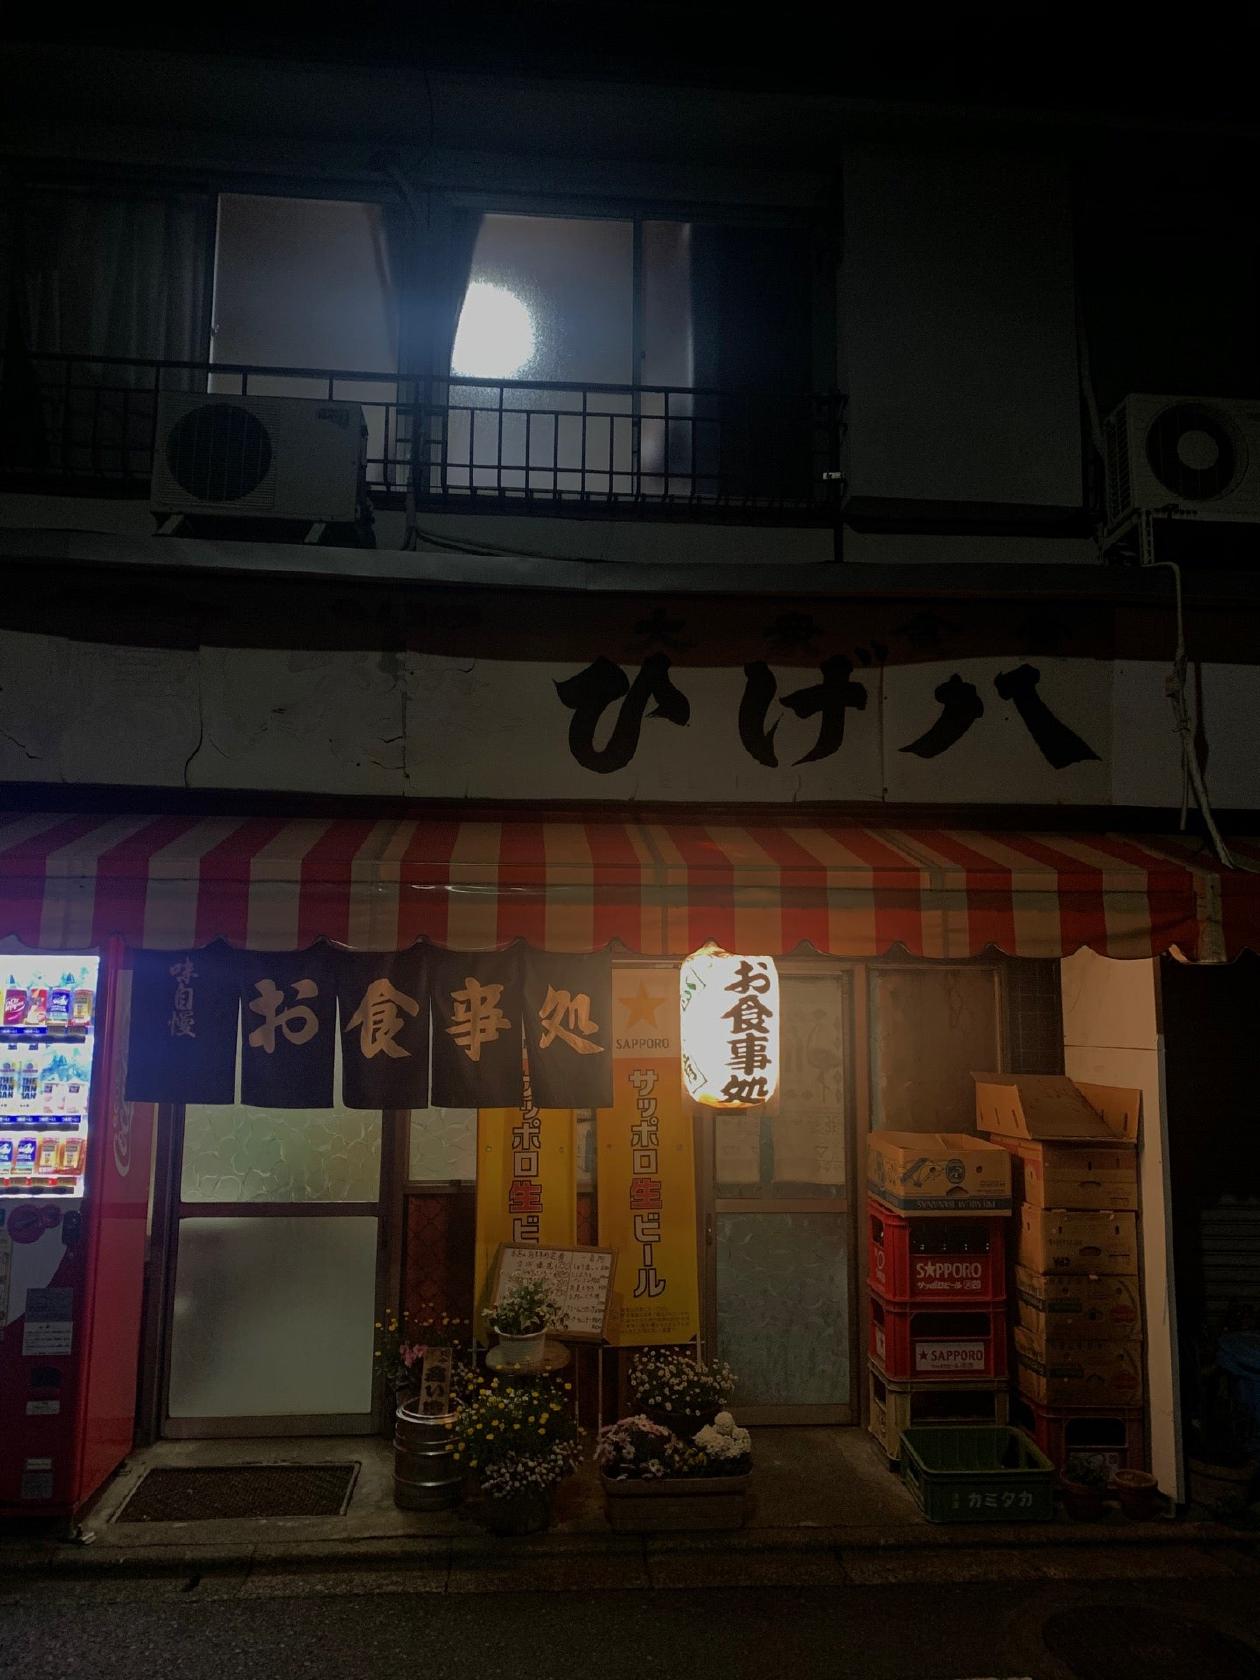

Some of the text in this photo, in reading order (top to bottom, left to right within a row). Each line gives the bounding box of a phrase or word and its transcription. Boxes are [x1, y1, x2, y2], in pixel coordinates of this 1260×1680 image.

[552, 641, 1103, 773] ひげ八
[167, 957, 199, 1039] 味自慢
[247, 976, 606, 1062] お食事処
[719, 960, 774, 1104] お食事処
[615, 1038, 670, 1050] SAPPORO
[628, 1068, 666, 1298] サッポロ生ビール
[930, 1350, 983, 1362] SAPPORO
[968, 1489, 1034, 1509] カミタカ
